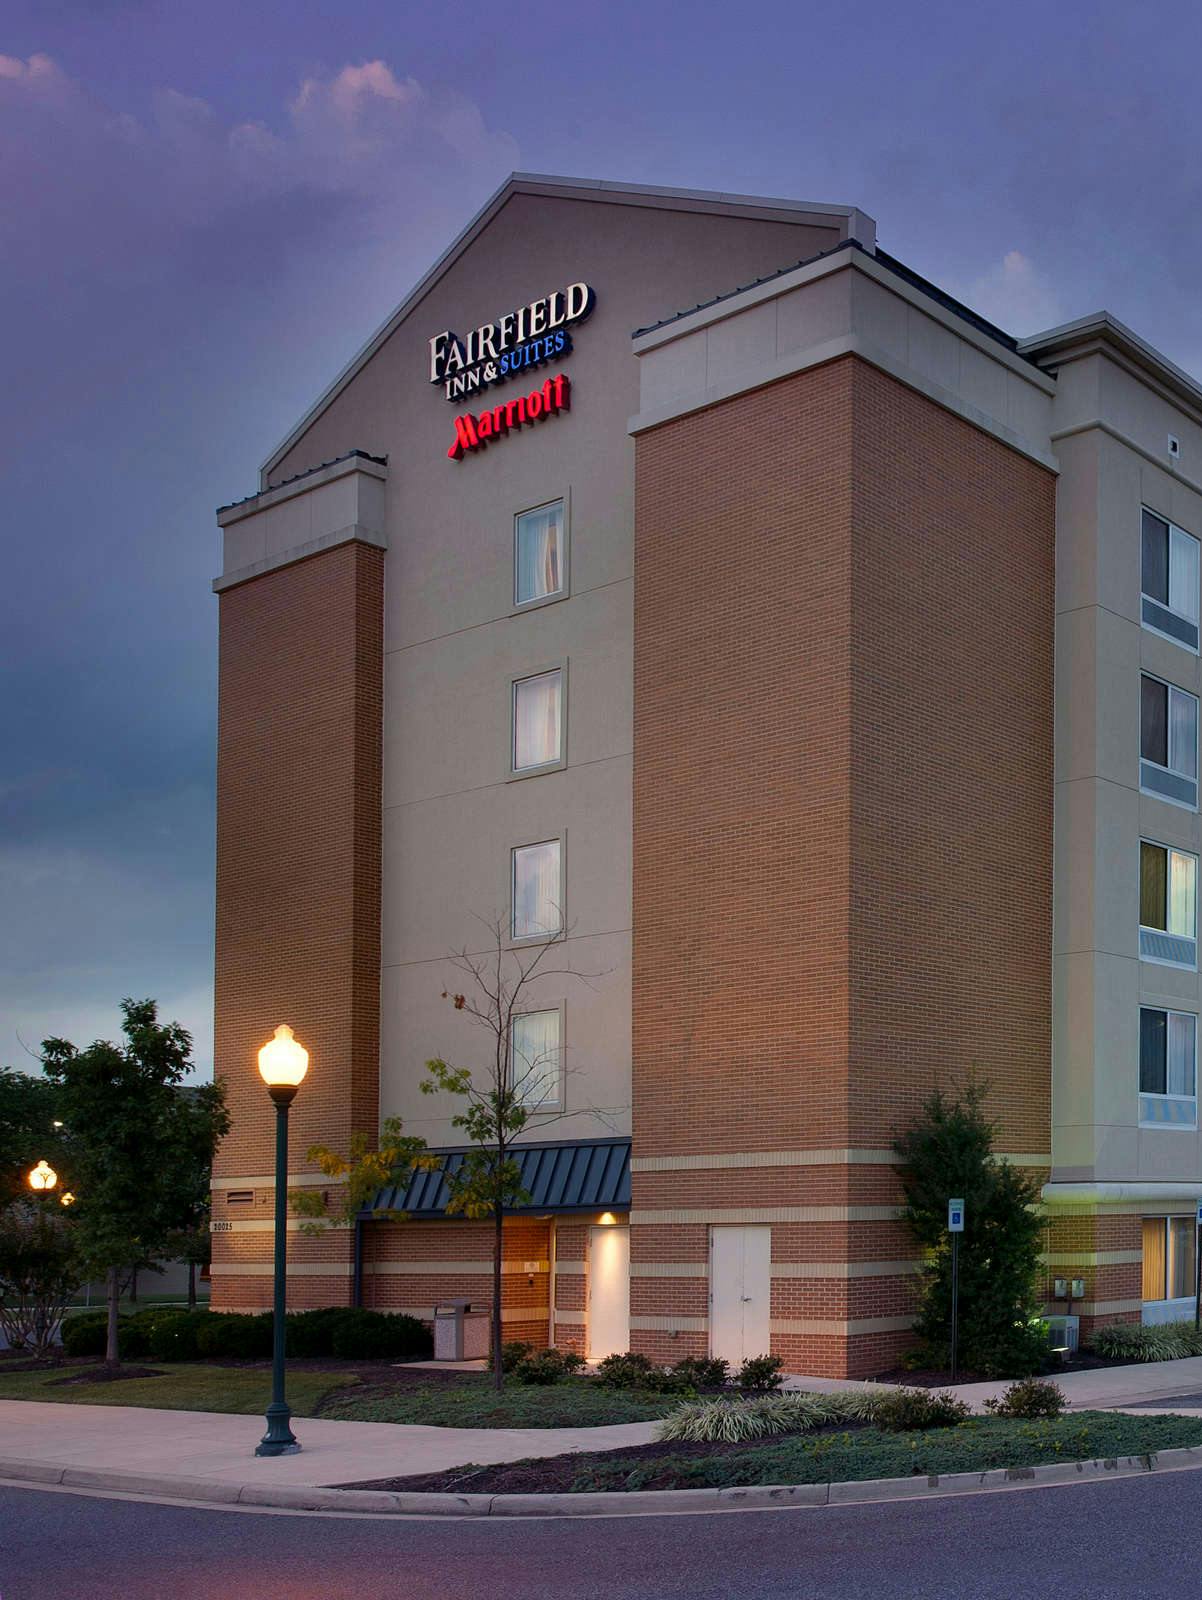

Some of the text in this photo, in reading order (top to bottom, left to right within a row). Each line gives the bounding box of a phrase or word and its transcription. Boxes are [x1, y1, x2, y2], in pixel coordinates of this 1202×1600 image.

[428, 282, 592, 384] FAIRFIELD
[499, 331, 568, 376] SUITES
[448, 374, 571, 461] Marriott
